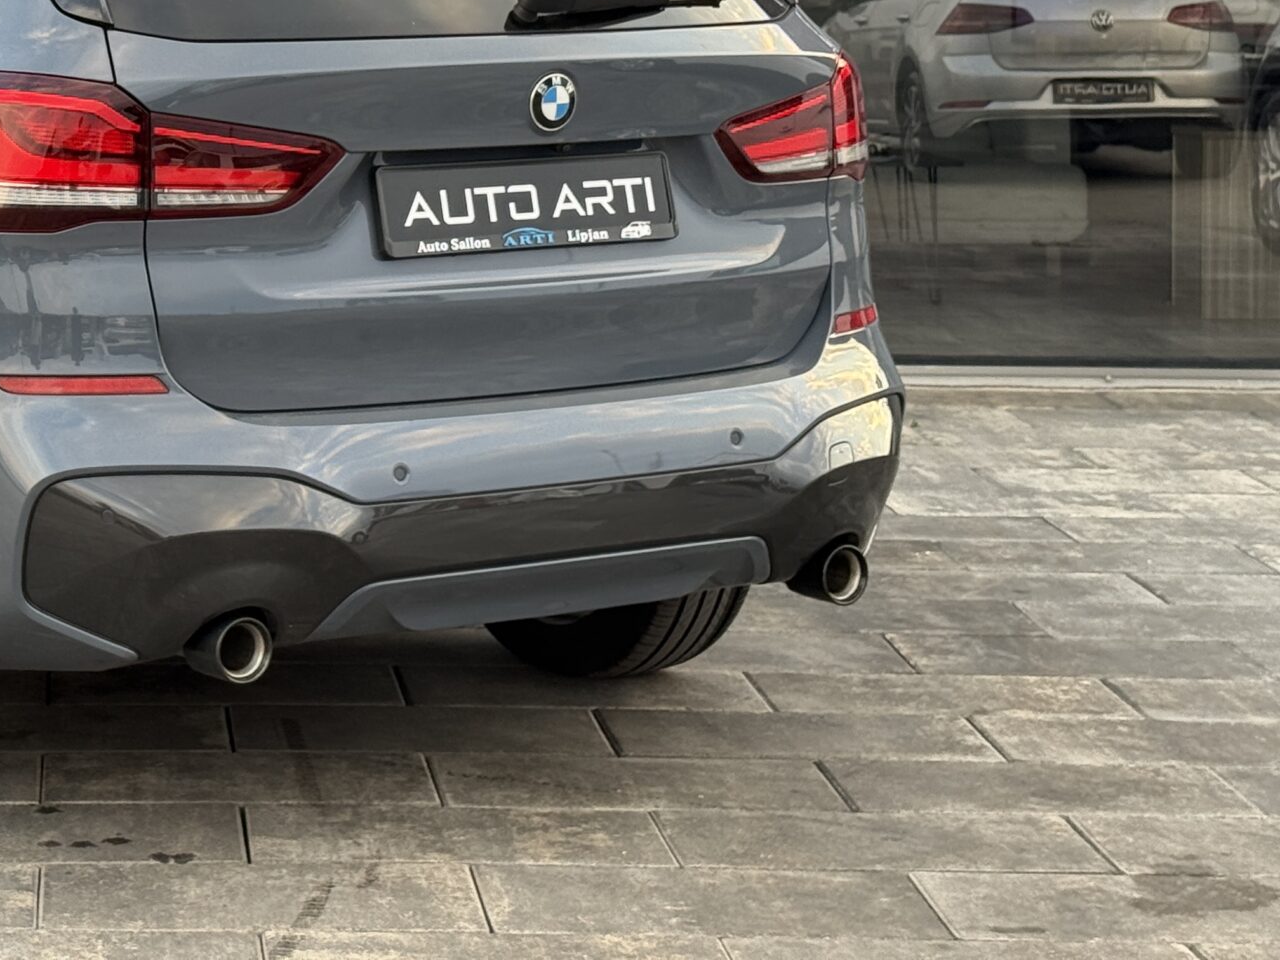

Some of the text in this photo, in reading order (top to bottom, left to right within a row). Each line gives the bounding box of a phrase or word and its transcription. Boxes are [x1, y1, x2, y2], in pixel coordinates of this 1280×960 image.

[537, 76, 575, 96] BMW
[404, 177, 656, 227] AUTO ARTI
[417, 240, 449, 254] Auto
[504, 232, 555, 246] ARTI
[567, 229, 609, 244] Lipjan
